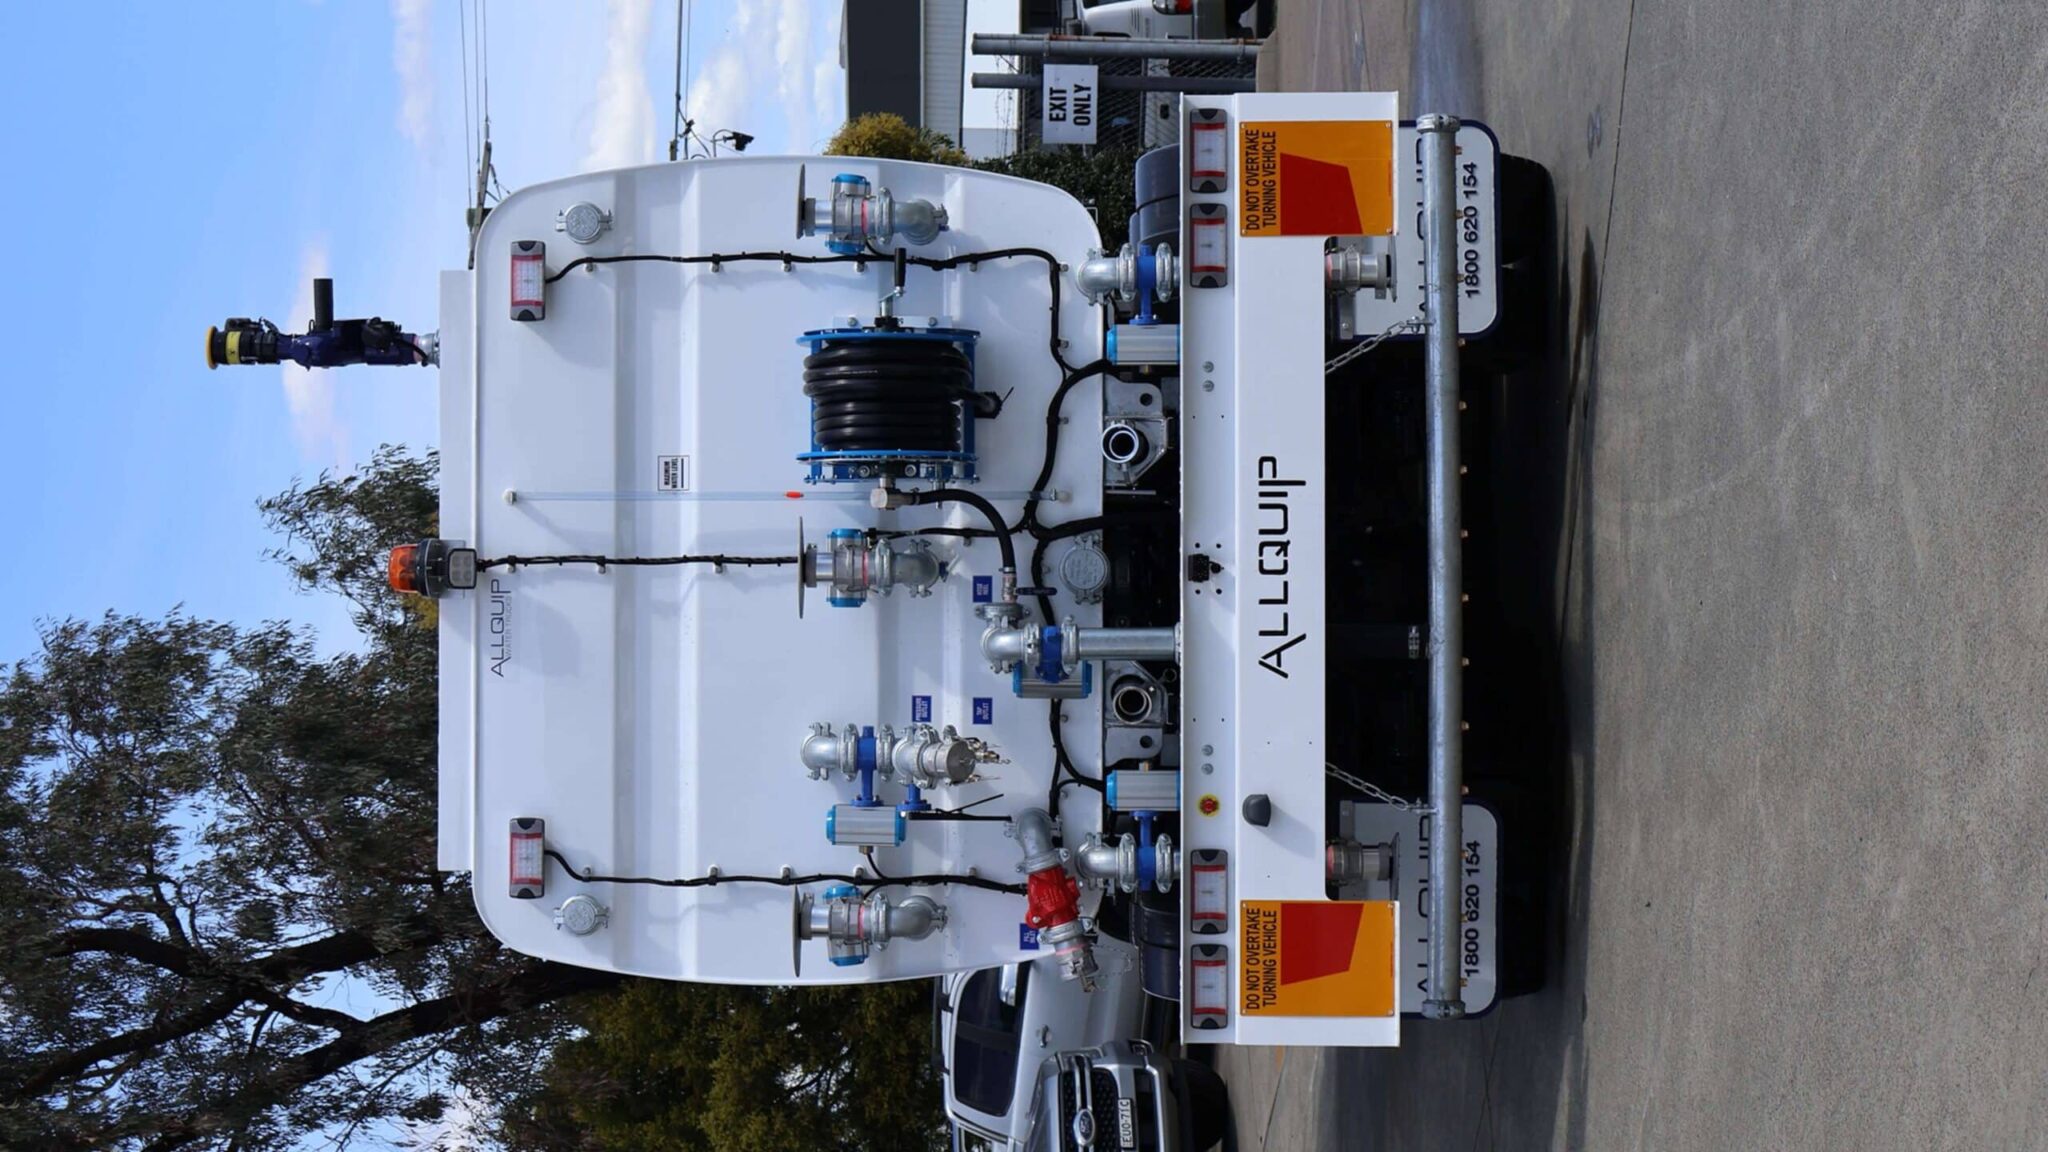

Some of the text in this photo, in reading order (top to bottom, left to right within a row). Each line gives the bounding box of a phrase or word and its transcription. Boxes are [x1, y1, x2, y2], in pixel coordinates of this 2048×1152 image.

[1049, 87, 1067, 122] EXIT
[1073, 84, 1091, 126] ONLY
[1245, 129, 1260, 230] DO NOT OVERTAKE
[1262, 131, 1276, 227] TURNING VEHICLE
[1463, 162, 1480, 298] 1800 620 154
[1258, 456, 1306, 679] ALLQUIP
[491, 579, 511, 677] ALLQUIP
[1246, 908, 1260, 1009] DO NOT OVERTAKE
[1263, 910, 1277, 1006] TURNING VEHICLE
[1464, 840, 1480, 978] 1800 620 154
